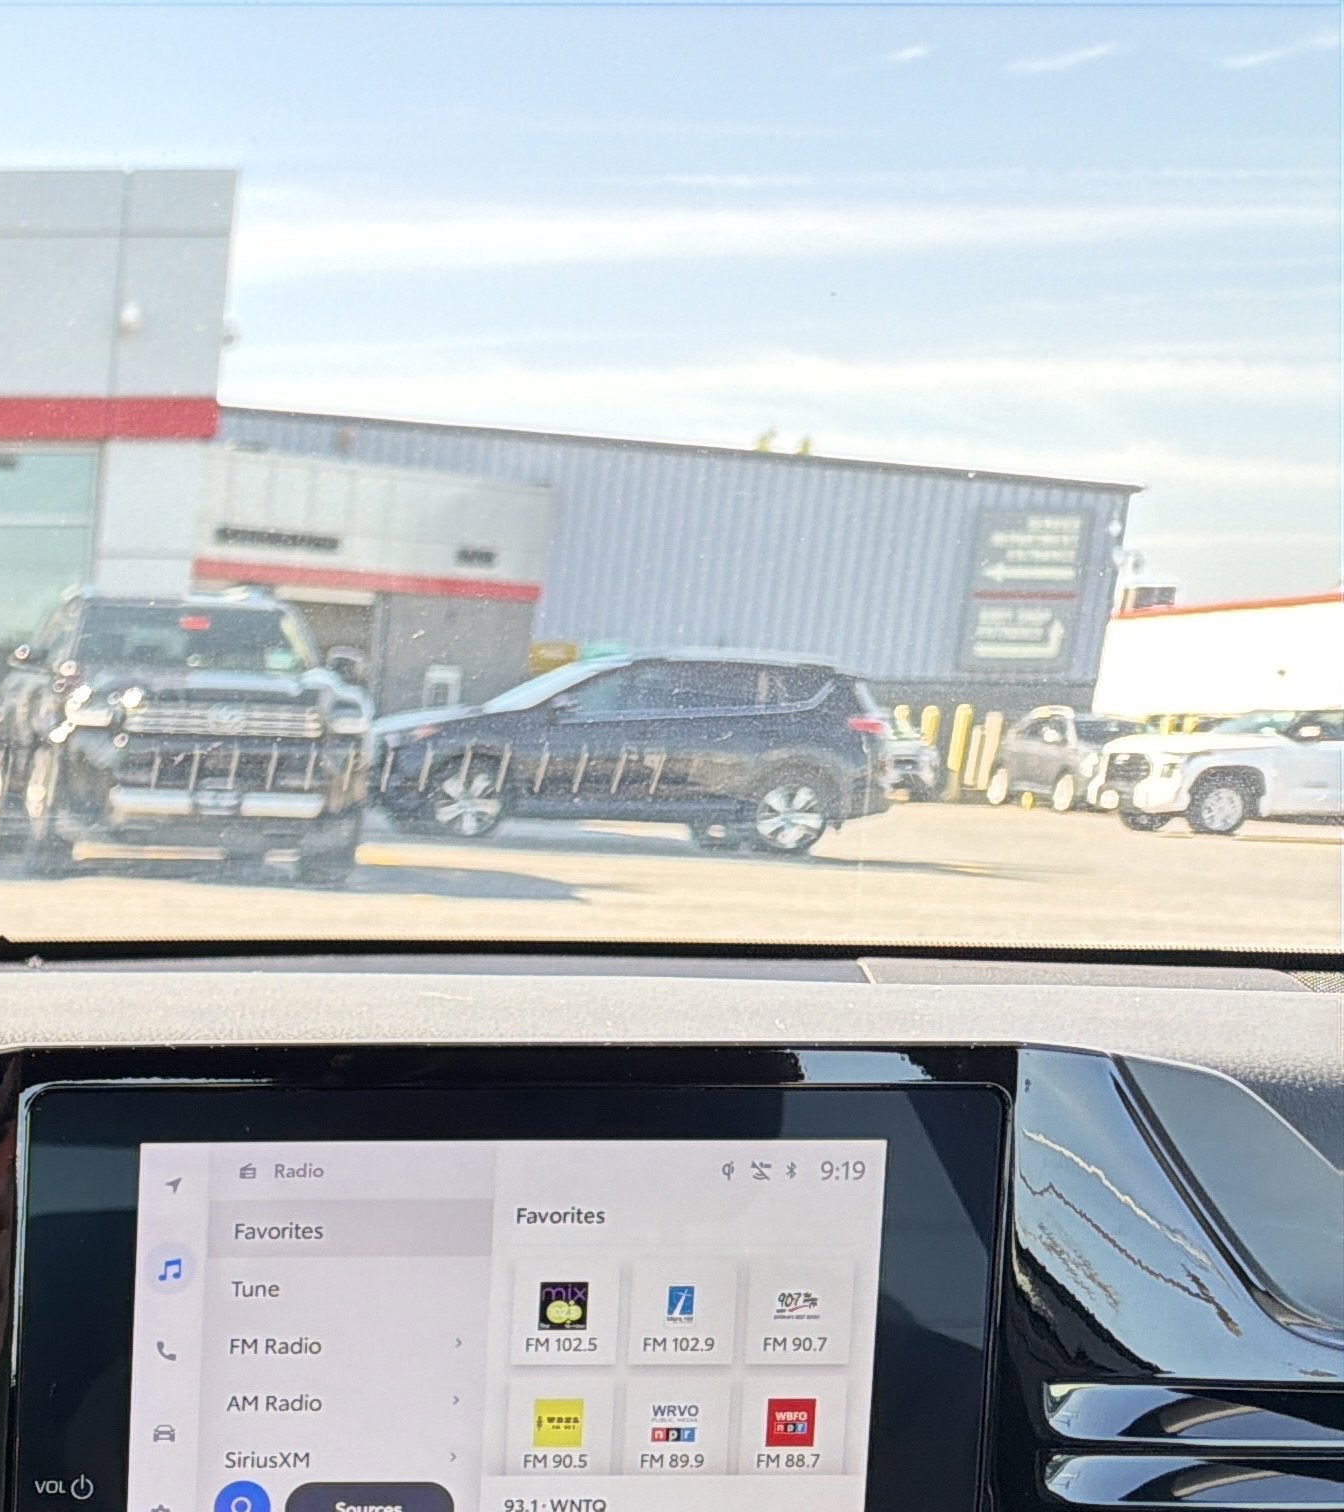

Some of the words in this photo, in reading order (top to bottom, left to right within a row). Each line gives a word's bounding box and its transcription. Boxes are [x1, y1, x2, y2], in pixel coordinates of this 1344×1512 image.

[274, 1163, 324, 1180] Radio
[820, 1160, 866, 1182] 9:19
[517, 1207, 606, 1225] Favorites
[234, 1222, 324, 1241] Favorites
[232, 1280, 280, 1299] Tune
[543, 1284, 586, 1300] mix
[229, 1338, 259, 1355] FM
[265, 1337, 322, 1356] Radio
[525, 1338, 550, 1352] FM
[554, 1338, 598, 1353] 102.5
[643, 1338, 667, 1352] FM
[672, 1338, 715, 1353] 102.9
[763, 1337, 787, 1352] FM
[791, 1337, 827, 1353] 90.7
[226, 1395, 260, 1412] AM
[265, 1394, 323, 1412] Radio
[652, 1404, 699, 1417] WRVO
[653, 1429, 693, 1442] npr
[224, 1450, 311, 1470] SiriusXM
[523, 1454, 549, 1469] FM
[552, 1454, 588, 1469] 90.5
[640, 1454, 665, 1468] FM
[668, 1454, 705, 1469] 89.9
[756, 1453, 782, 1468] FM
[785, 1453, 821, 1469] 88.7
[34, 1480, 66, 1496] VOL
